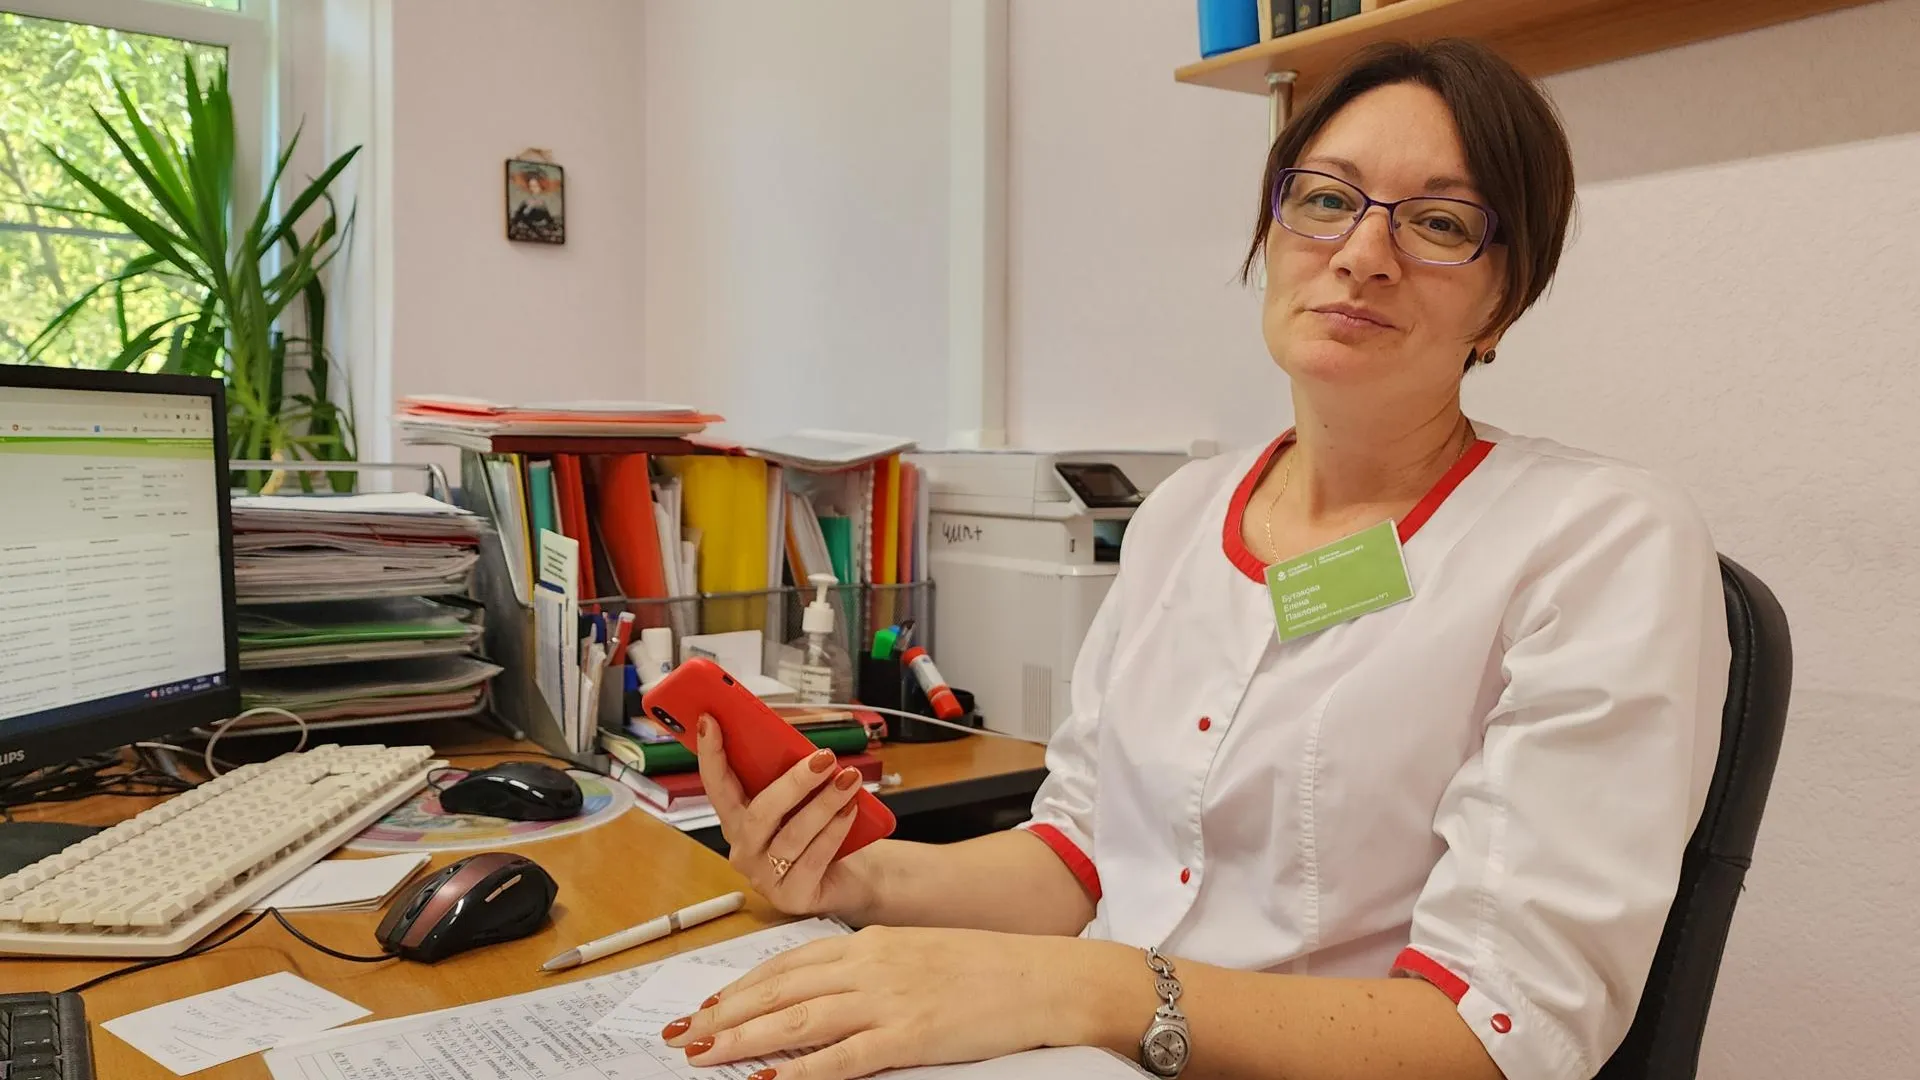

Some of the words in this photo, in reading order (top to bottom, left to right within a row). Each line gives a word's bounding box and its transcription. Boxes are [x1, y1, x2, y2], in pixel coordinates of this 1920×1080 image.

[1282, 585, 1320, 602] Бутакова
[1284, 599, 1309, 613] Елена
[1285, 603, 1327, 621] Павловна
